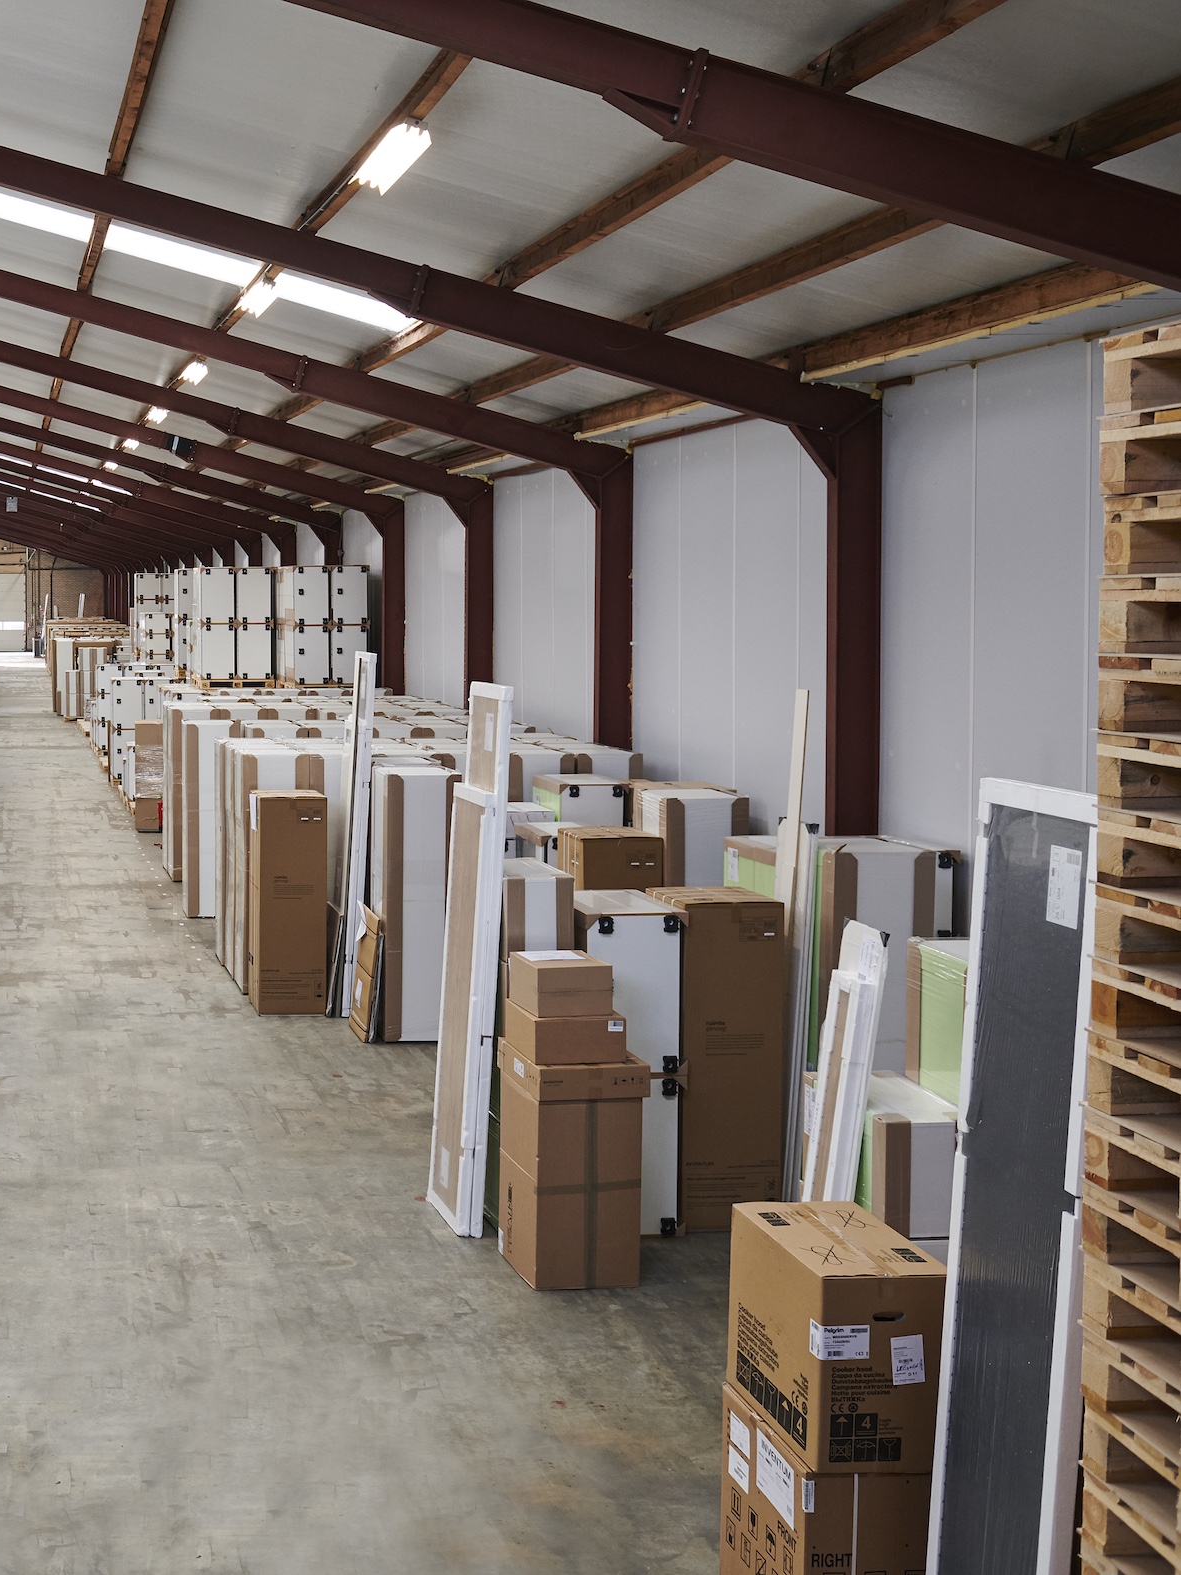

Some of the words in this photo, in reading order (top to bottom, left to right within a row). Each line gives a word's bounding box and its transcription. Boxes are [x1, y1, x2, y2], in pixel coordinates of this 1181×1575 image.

[861, 1415, 872, 1430] 4
[761, 1439, 792, 1482] INVENTUM
[777, 1520, 797, 1553] FRONT
[811, 1553, 852, 1568] RIGHT
